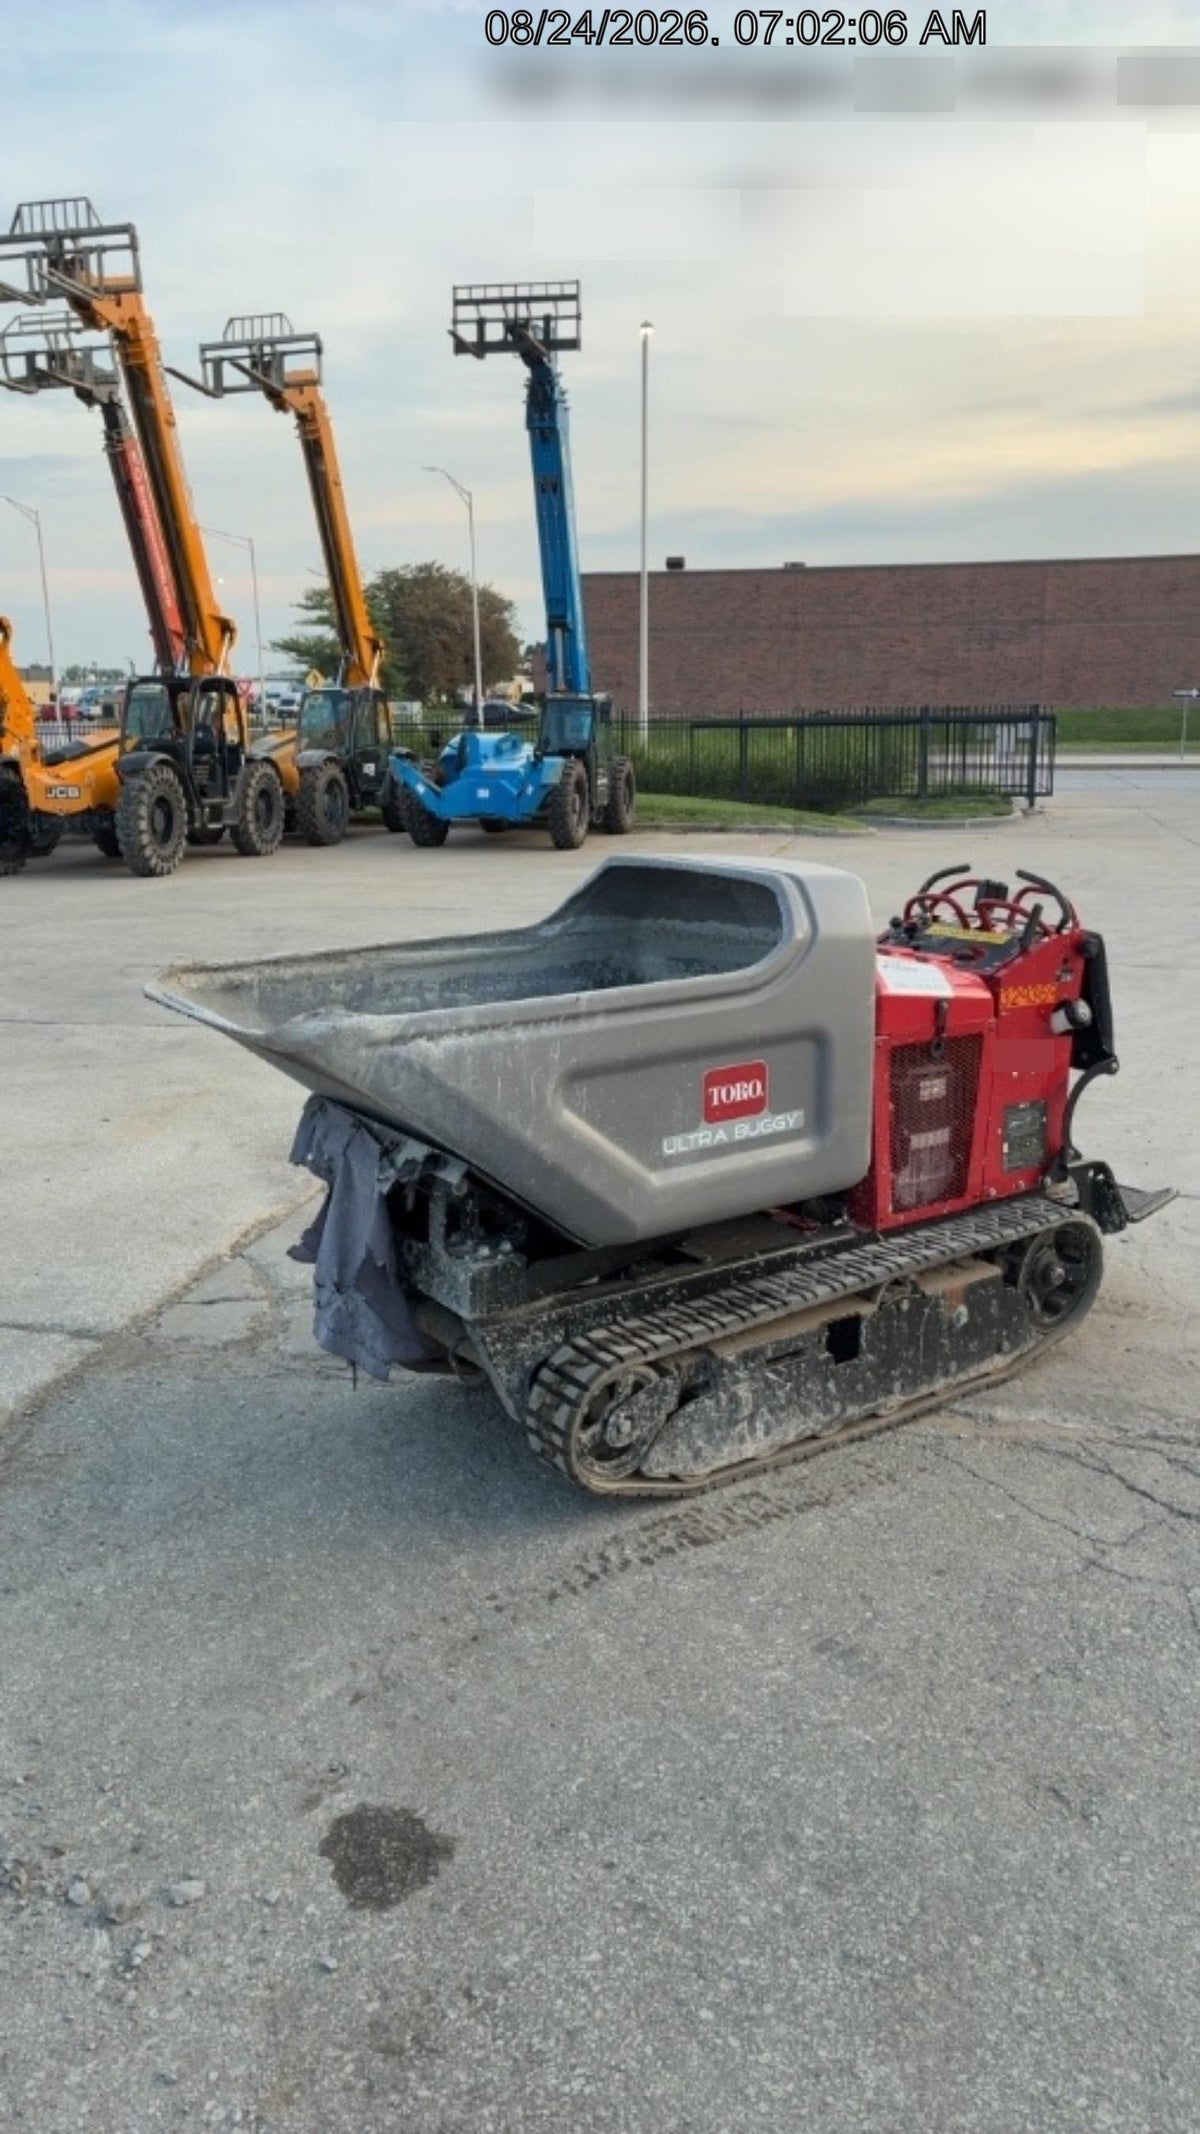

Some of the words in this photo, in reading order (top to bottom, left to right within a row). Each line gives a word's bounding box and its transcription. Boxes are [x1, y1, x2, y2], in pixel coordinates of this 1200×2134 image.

[46, 786, 80, 798] JCB
[663, 1130, 728, 1155] ULTRA
[734, 1113, 797, 1138] BUGGY
